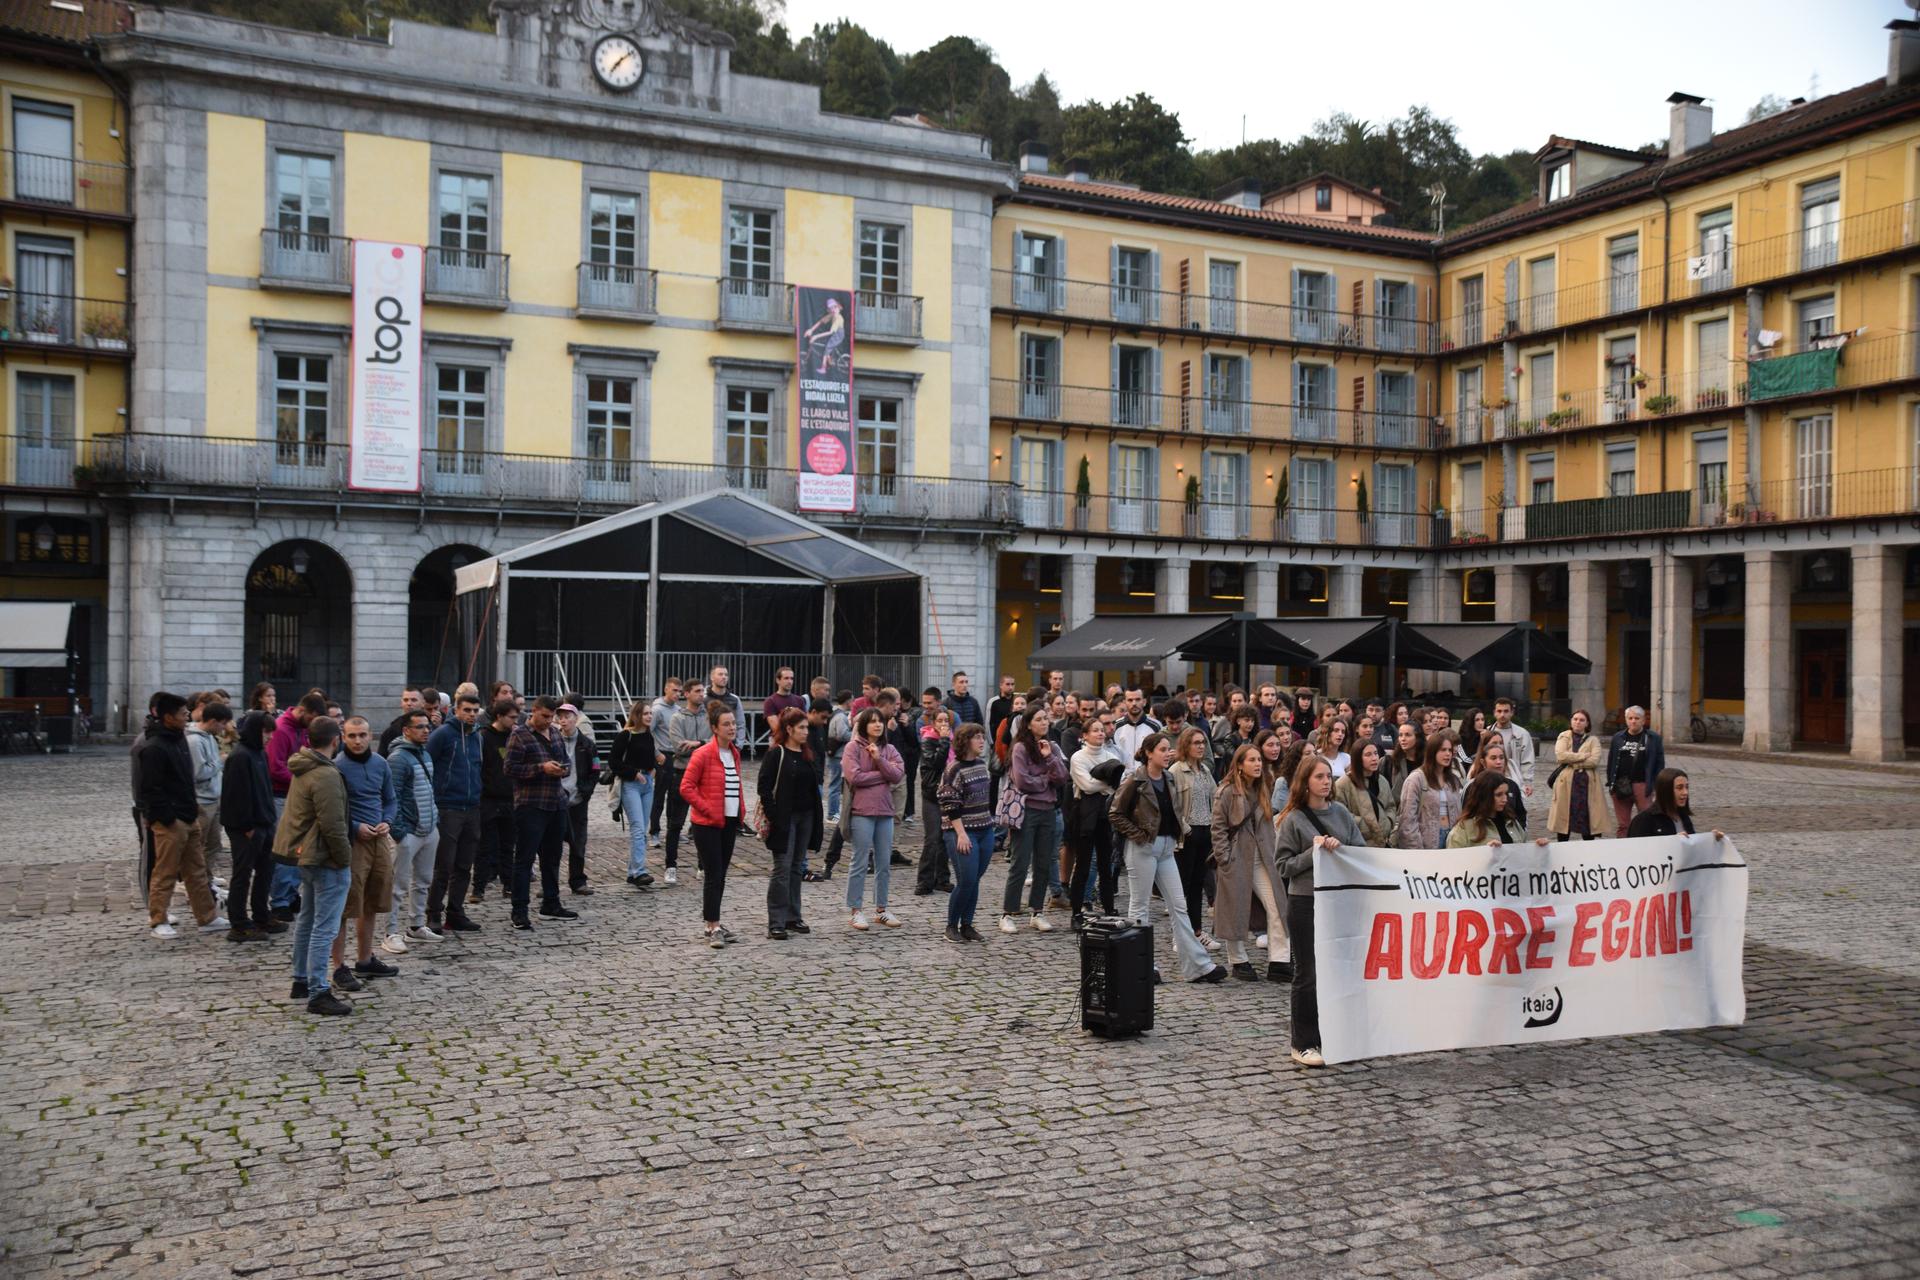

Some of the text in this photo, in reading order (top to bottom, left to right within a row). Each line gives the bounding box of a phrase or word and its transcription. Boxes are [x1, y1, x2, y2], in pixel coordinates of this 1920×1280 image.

[366, 296, 411, 364] top
[801, 419, 809, 428] DE
[802, 407, 849, 420] EL LARGO VIAJE
[1403, 856, 1674, 900] indarkeria matxista orori
[1364, 889, 1693, 980] AURRE EGIN!
[1522, 993, 1555, 1014] itaia
